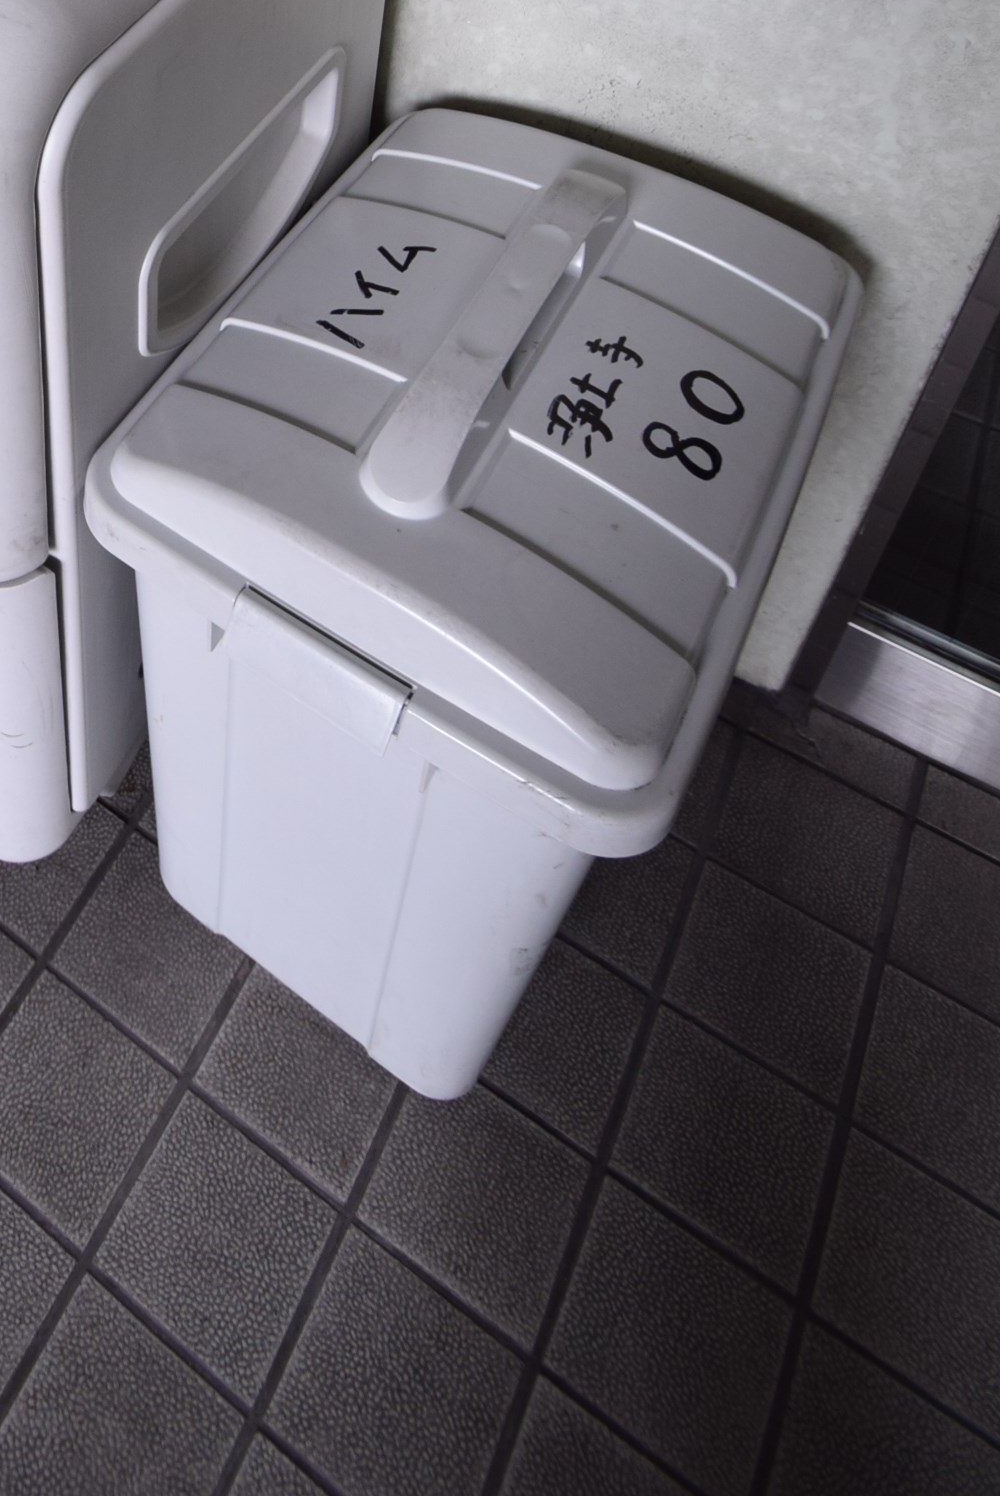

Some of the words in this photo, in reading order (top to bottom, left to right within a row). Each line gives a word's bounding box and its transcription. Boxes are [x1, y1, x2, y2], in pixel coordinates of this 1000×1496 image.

[315, 245, 437, 349] ハイム
[641, 369, 745, 481] 80
